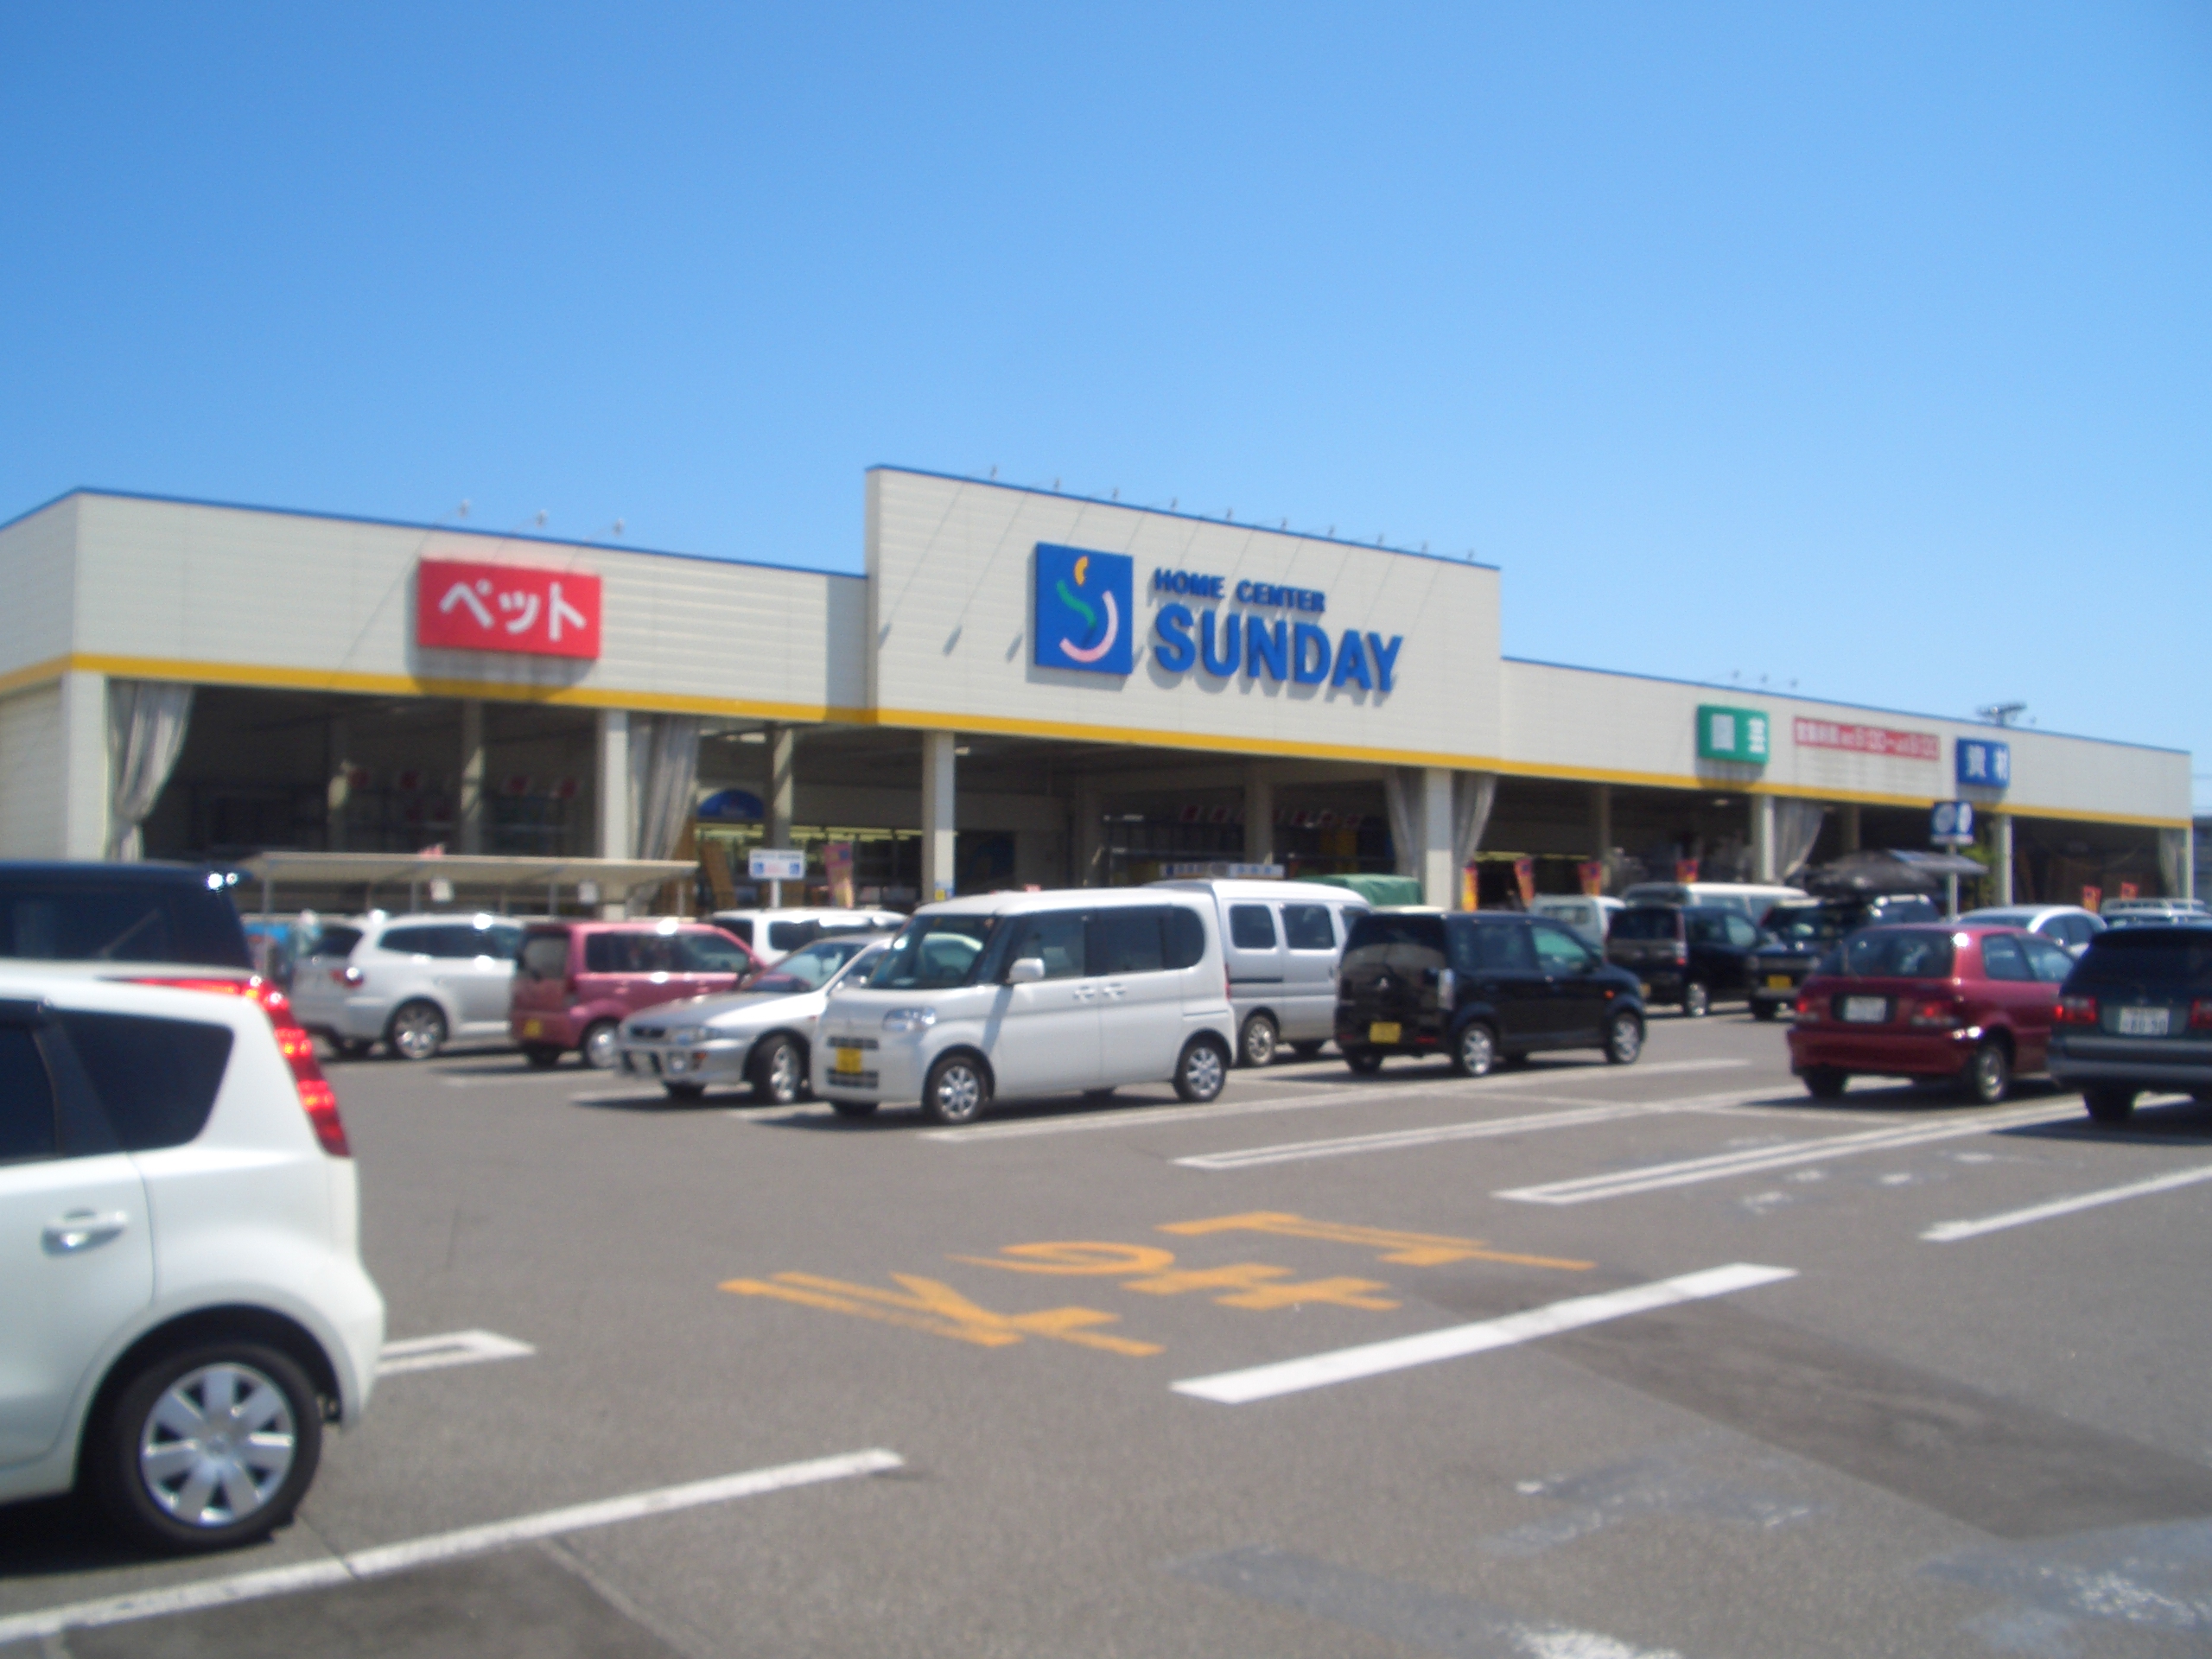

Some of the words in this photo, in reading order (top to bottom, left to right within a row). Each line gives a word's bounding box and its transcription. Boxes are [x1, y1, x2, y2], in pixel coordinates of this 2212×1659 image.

[439, 579, 586, 641] ペット
[1153, 567, 1225, 600] HOME
[1236, 579, 1325, 613] CENTER
[1154, 603, 1402, 691] SUNDAY
